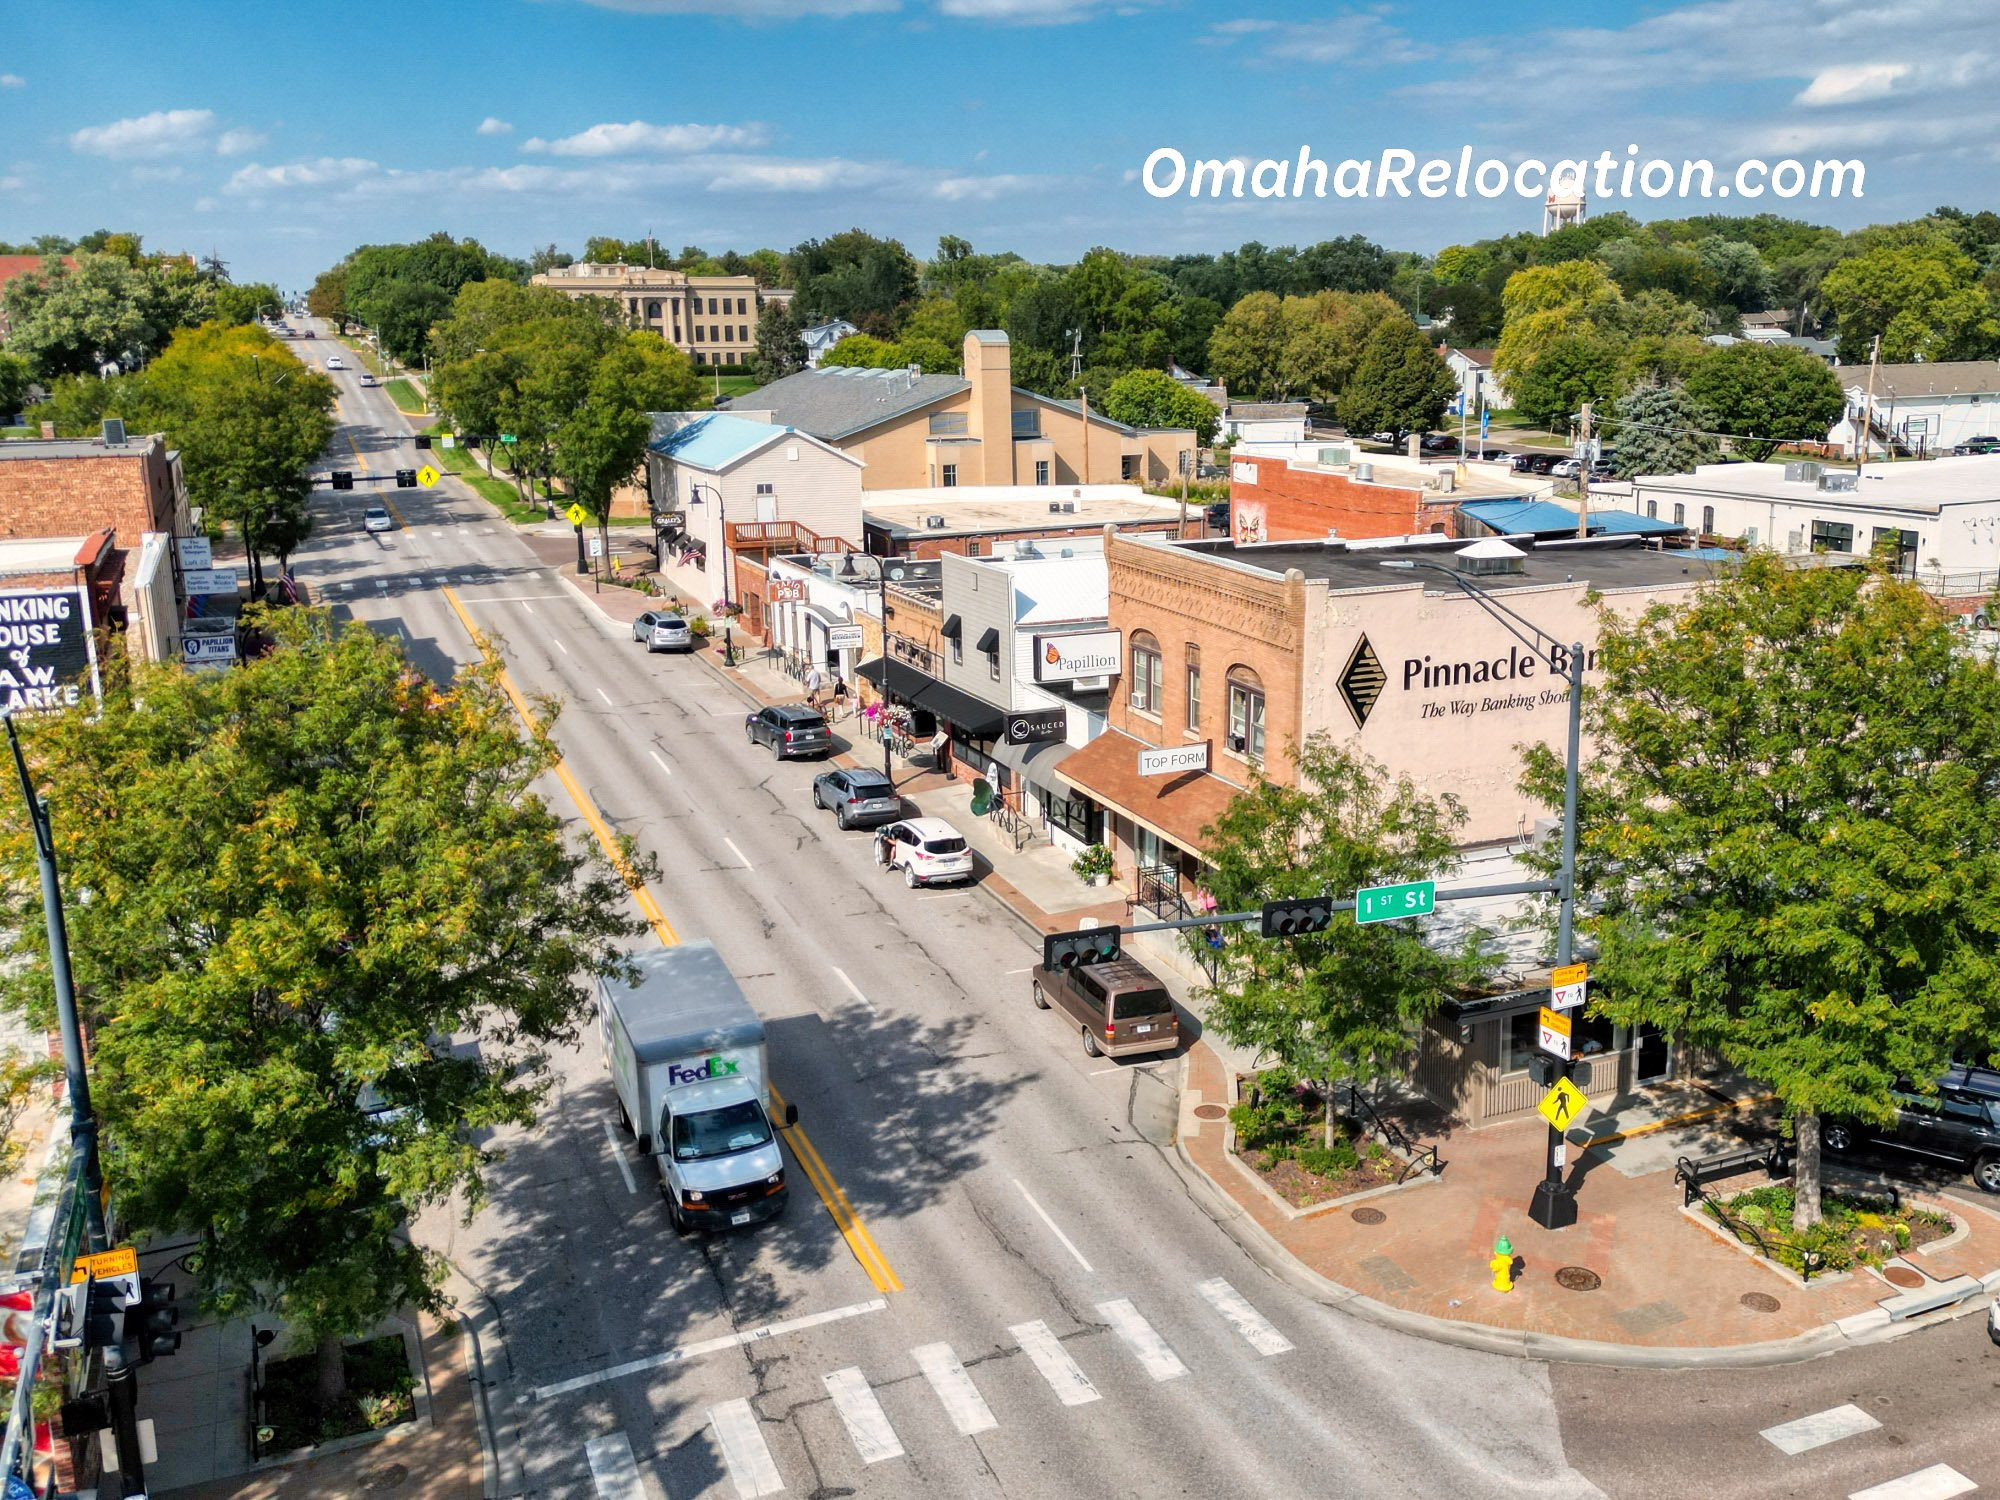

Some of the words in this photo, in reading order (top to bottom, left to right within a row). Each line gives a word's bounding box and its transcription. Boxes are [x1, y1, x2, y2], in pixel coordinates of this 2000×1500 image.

[202, 638, 233, 646] PAPILLION
[208, 645, 230, 653] TITANS
[9, 645, 31, 668] of
[1059, 654, 1116, 672] Papillion
[1403, 646, 1536, 691] Pinnacle
[1421, 702, 1446, 719] The
[1450, 700, 1478, 717] Way
[1480, 693, 1536, 713] Banking
[1030, 721, 1065, 731] SAUCED
[1144, 756, 1168, 769] TOP
[1171, 752, 1205, 766] FORM
[1405, 890, 1426, 909] St
[668, 1055, 740, 1086] FedEx
[91, 1252, 131, 1266] TURNING
[93, 1263, 133, 1276] VEHICLES
